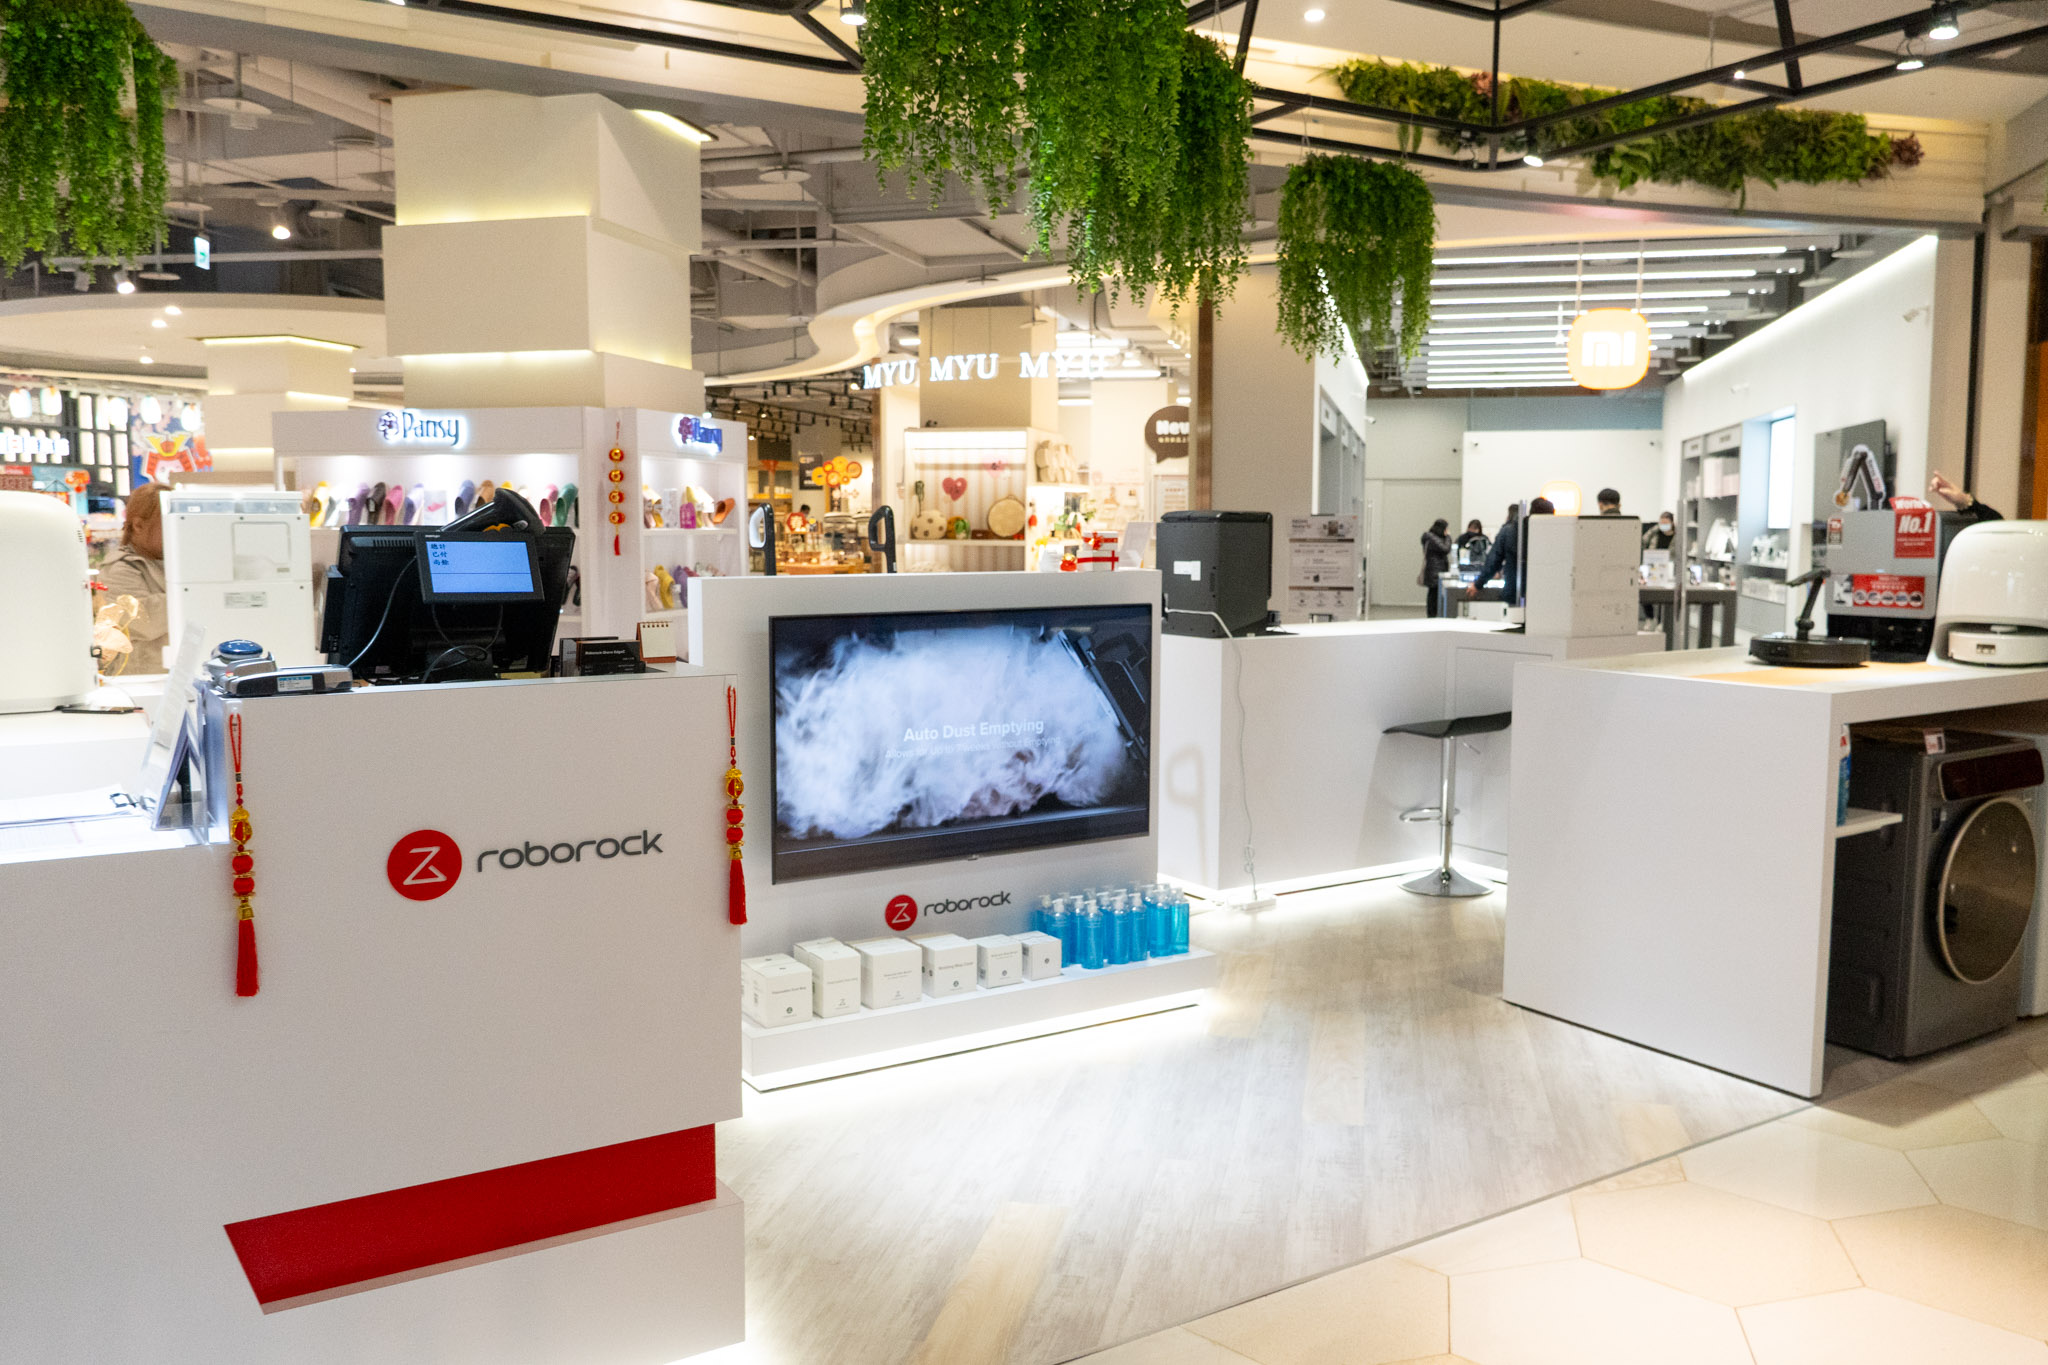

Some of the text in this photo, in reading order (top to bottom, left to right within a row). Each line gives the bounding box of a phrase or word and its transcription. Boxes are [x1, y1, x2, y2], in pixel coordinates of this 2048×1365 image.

[863, 352, 1106, 389] MYU MYU MYU
[402, 412, 461, 446] Pansy
[1898, 511, 1933, 534] No.1
[903, 719, 1044, 742] Auto Dust Emptying
[477, 829, 663, 873] roborock
[923, 891, 1011, 917] roborock
